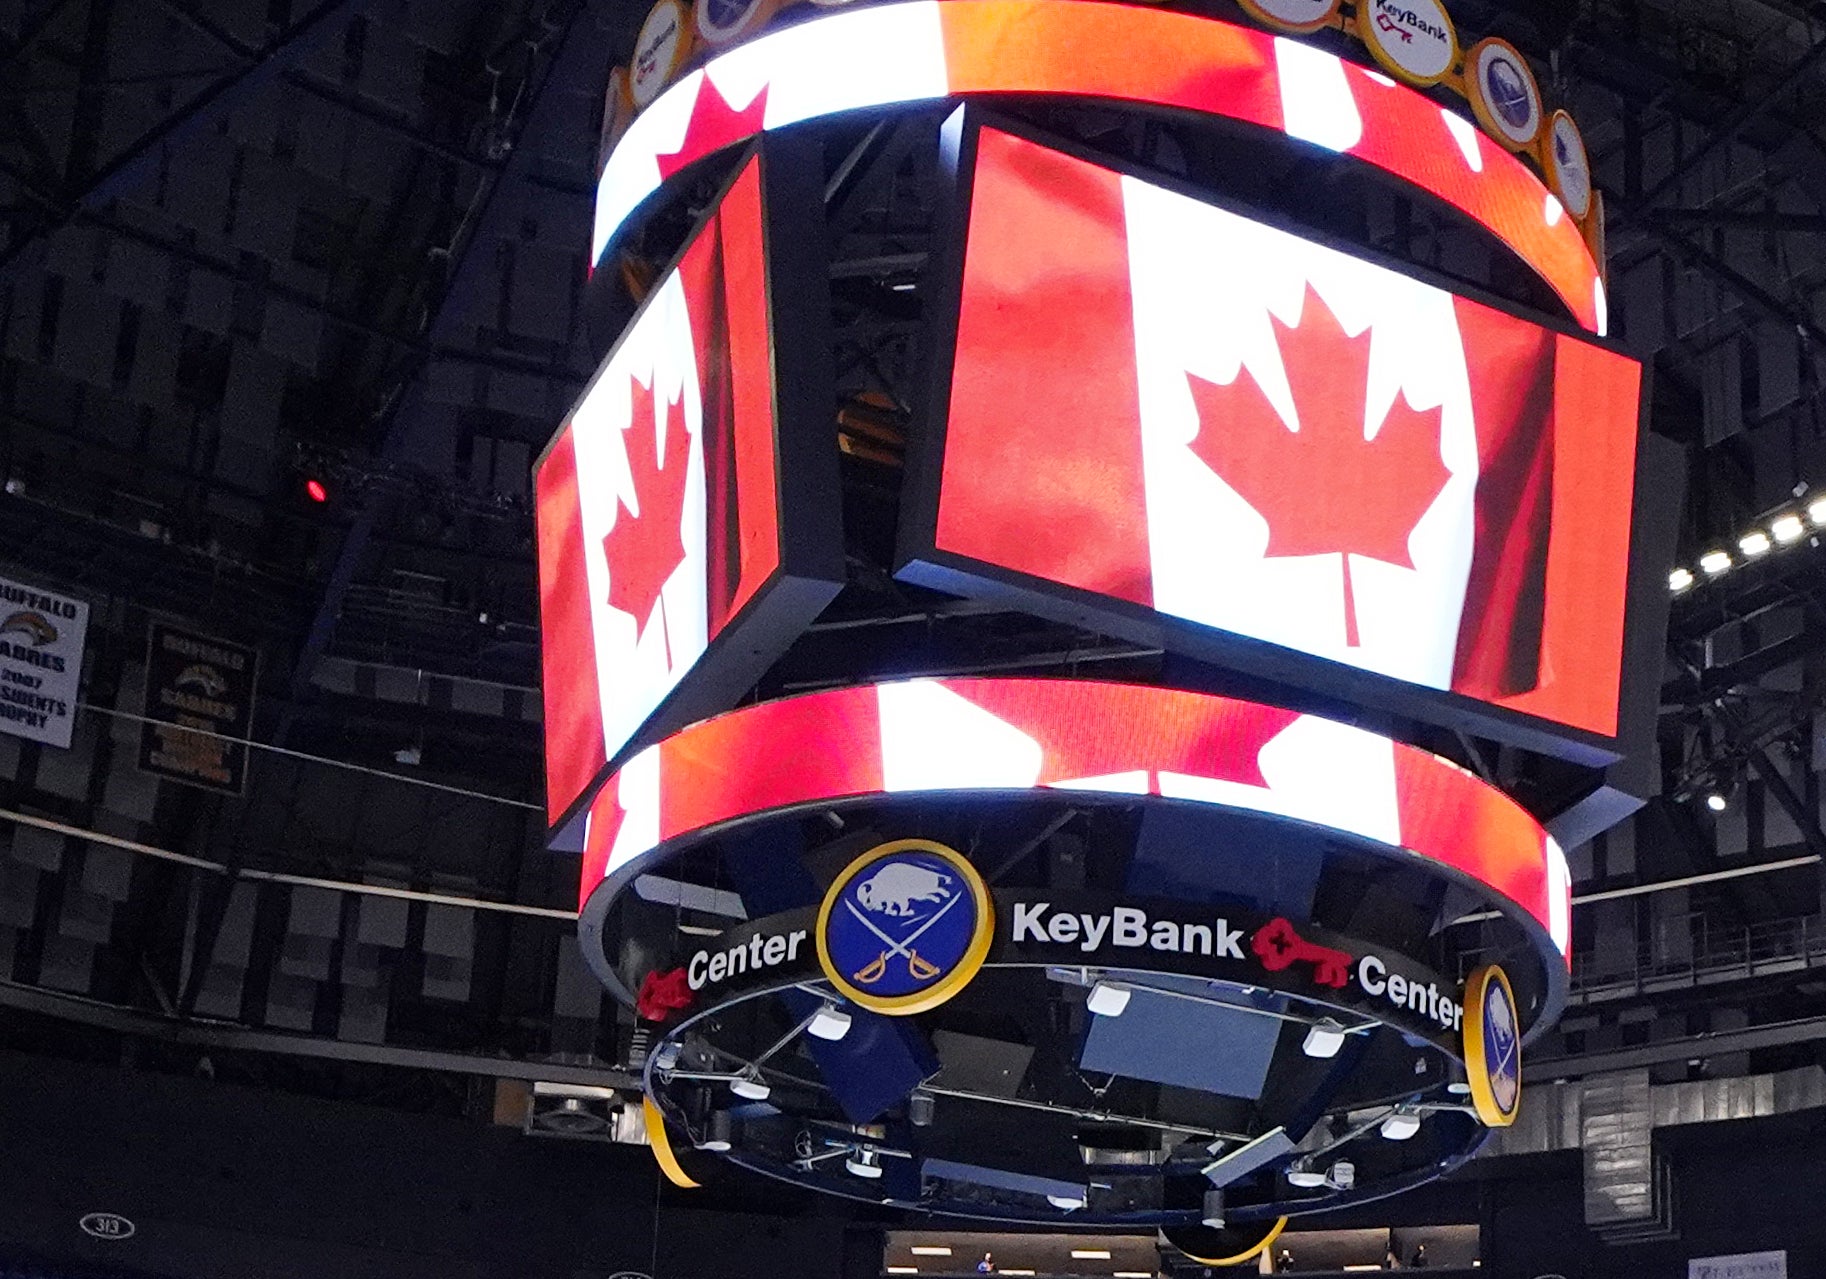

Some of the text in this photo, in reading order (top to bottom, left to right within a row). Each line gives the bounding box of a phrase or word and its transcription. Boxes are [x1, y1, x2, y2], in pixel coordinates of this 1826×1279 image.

[687, 929, 807, 991] Center
[1012, 903, 1464, 1032] KeyBank Center
